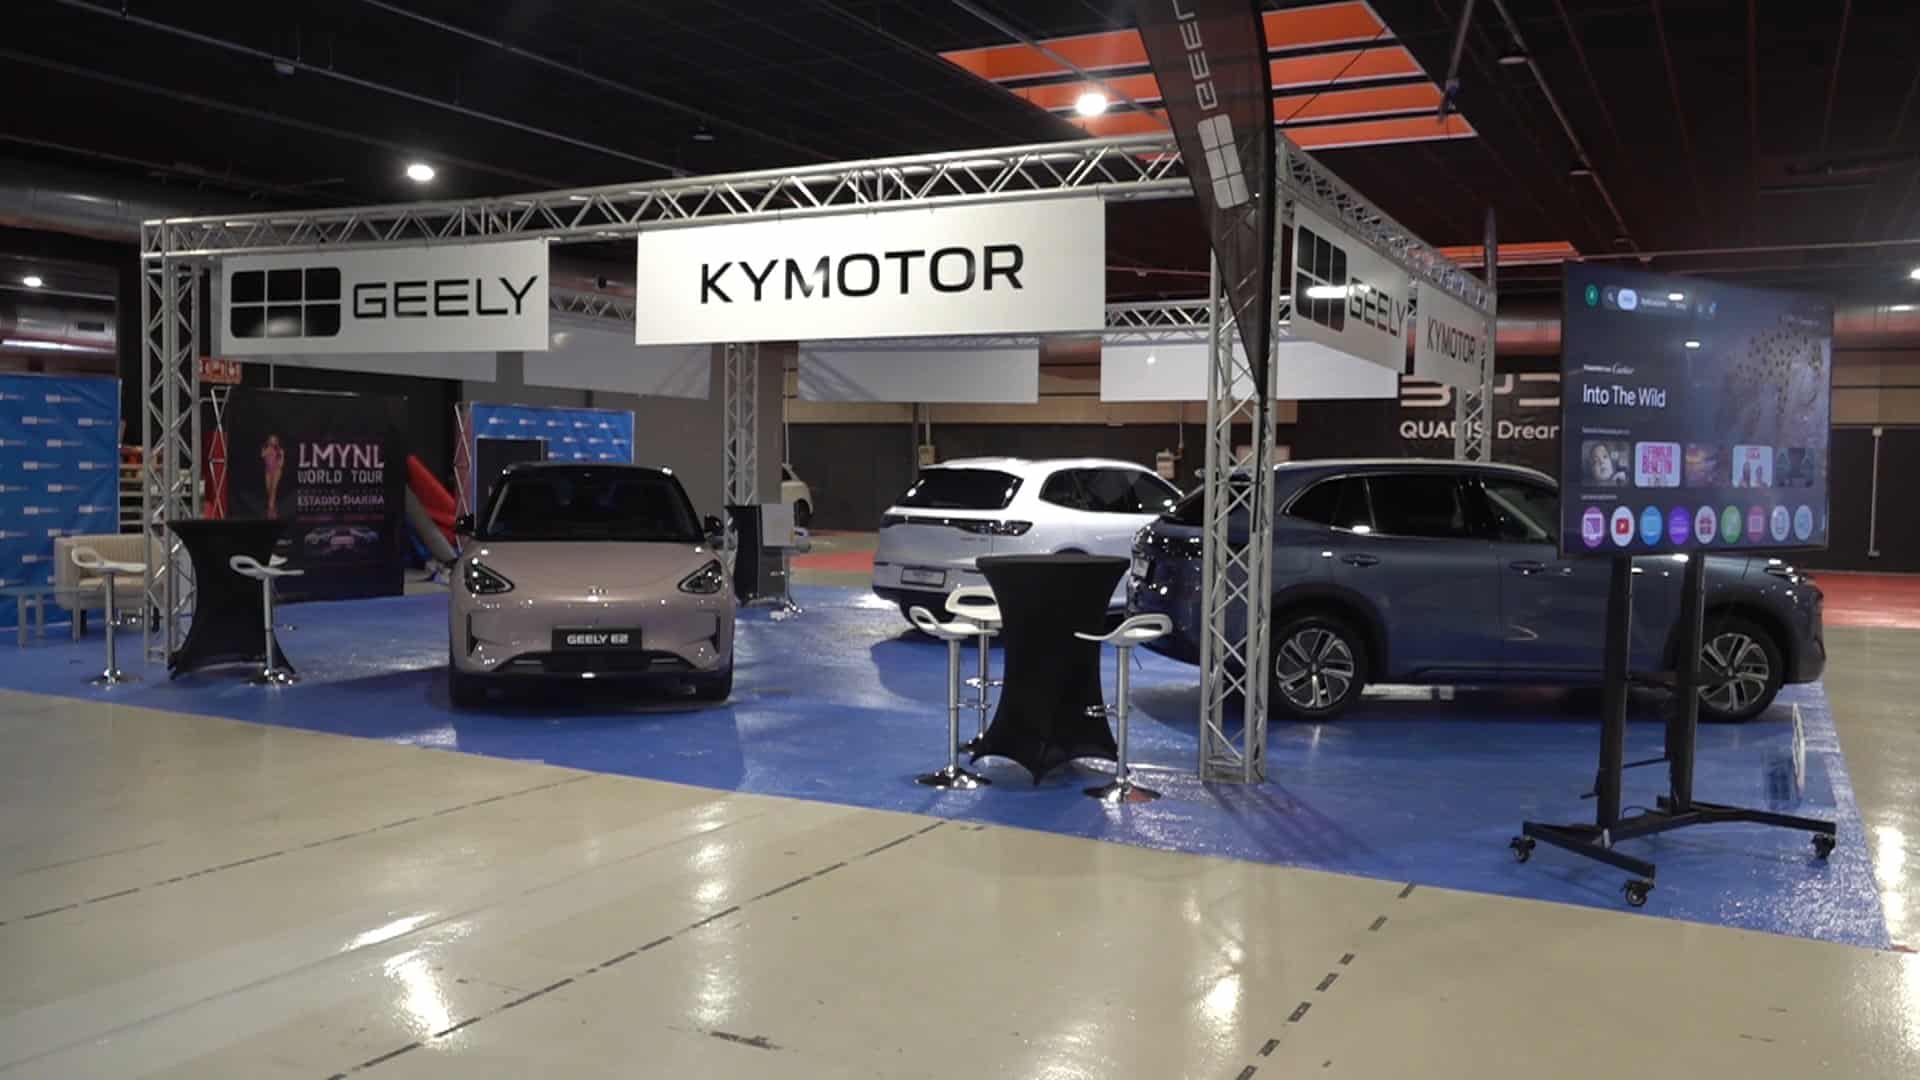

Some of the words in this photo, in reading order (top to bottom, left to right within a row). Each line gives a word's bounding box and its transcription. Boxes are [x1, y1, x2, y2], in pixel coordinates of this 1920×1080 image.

[701, 243, 1024, 304] KYMOTOR
[353, 275, 538, 319] GEELY
[1349, 277, 1406, 337] GEELY
[1426, 315, 1476, 365] KYMOTOR
[1583, 384, 1610, 405] Into
[1612, 385, 1637, 407] The
[1638, 387, 1666, 408] Wild
[1400, 420, 1485, 440] QUAIS
[298, 443, 385, 469] LMYNL
[297, 470, 343, 484] WORLD
[351, 470, 383, 484] TOUR
[567, 634, 608, 644] GEELY
